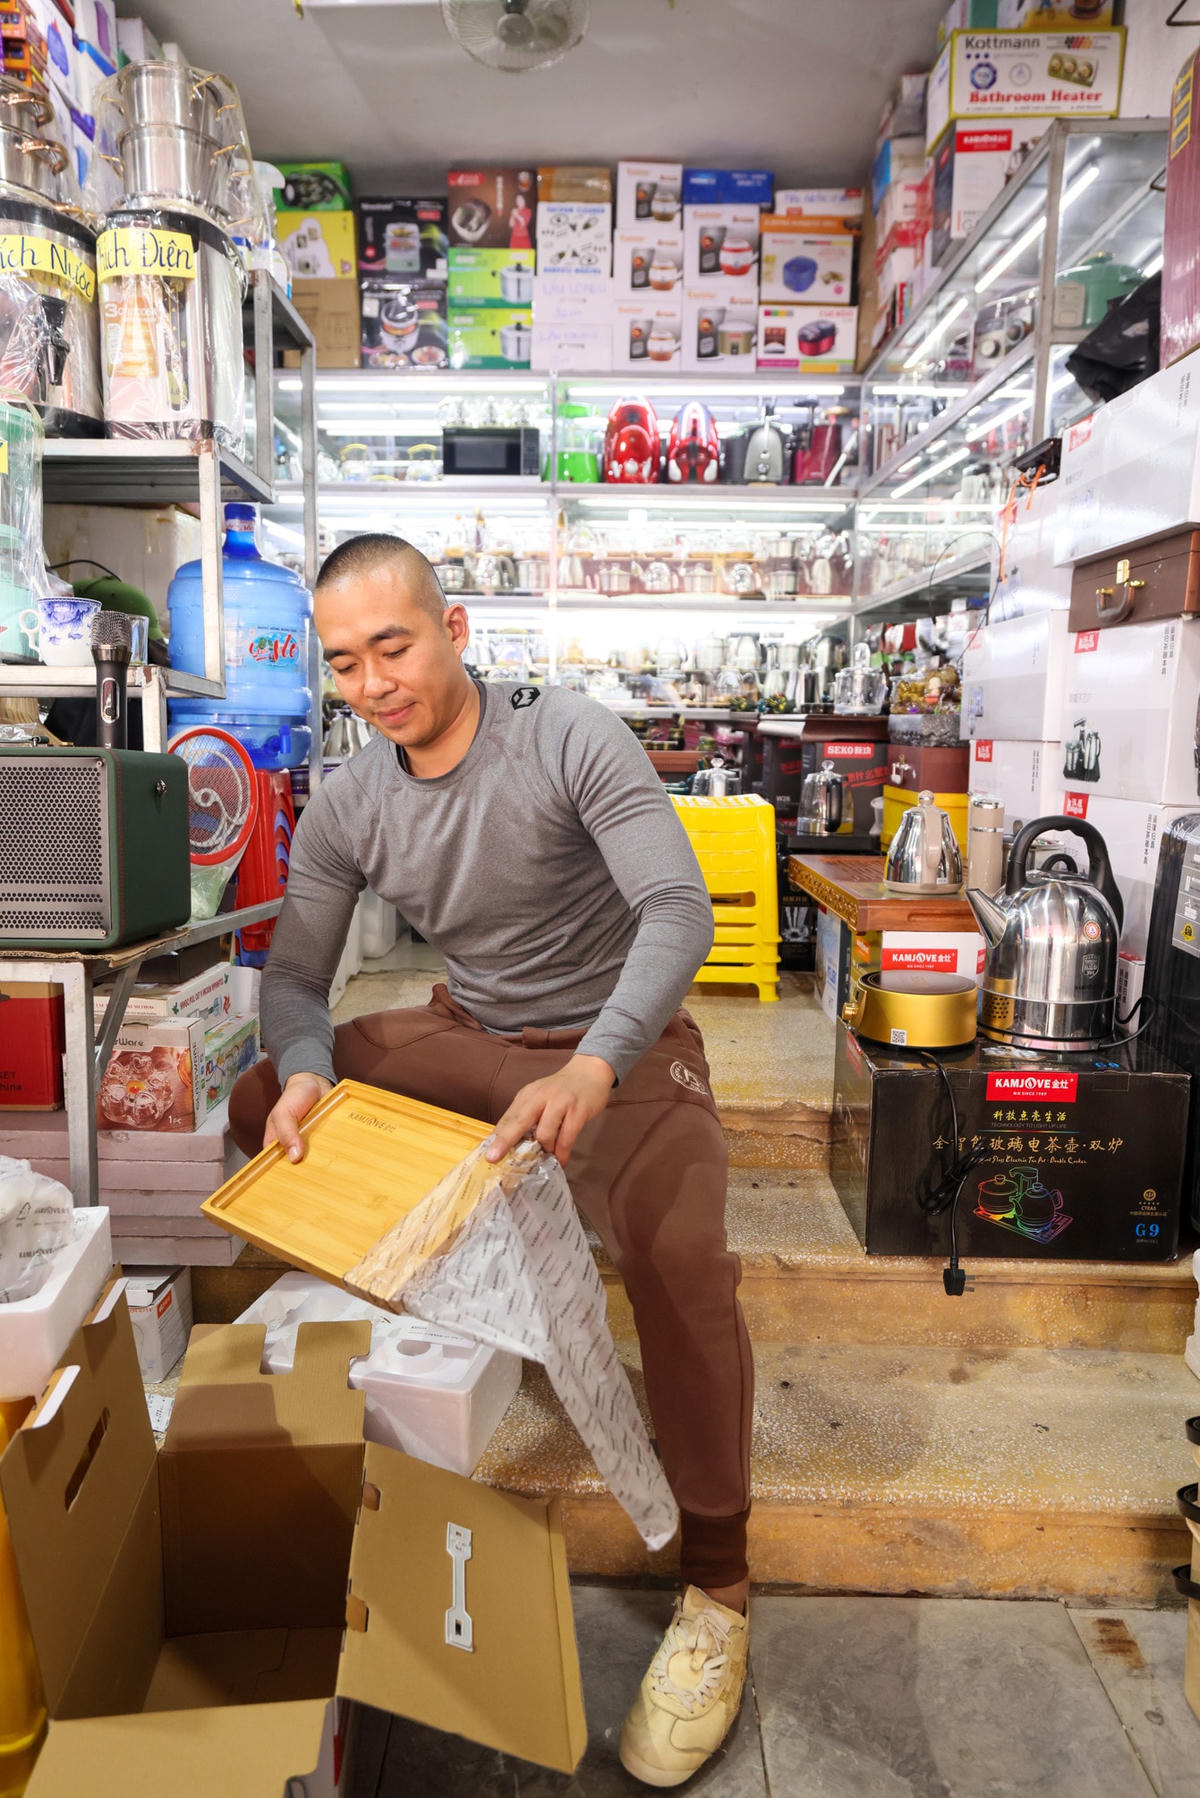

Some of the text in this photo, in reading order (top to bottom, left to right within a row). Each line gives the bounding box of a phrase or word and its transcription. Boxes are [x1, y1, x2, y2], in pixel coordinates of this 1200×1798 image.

[965, 36, 1040, 50] Kottmann
[969, 89, 1102, 104] Bathroom Heater
[141, 231, 193, 272] Điện
[827, 745, 853, 754] SEKO
[892, 952, 936, 963] KAMJOVE
[995, 1077, 1069, 1089] KAMJOVE 金灶
[993, 1109, 1067, 1122] 科技点亮生活
[1135, 1223, 1160, 1238] G9
